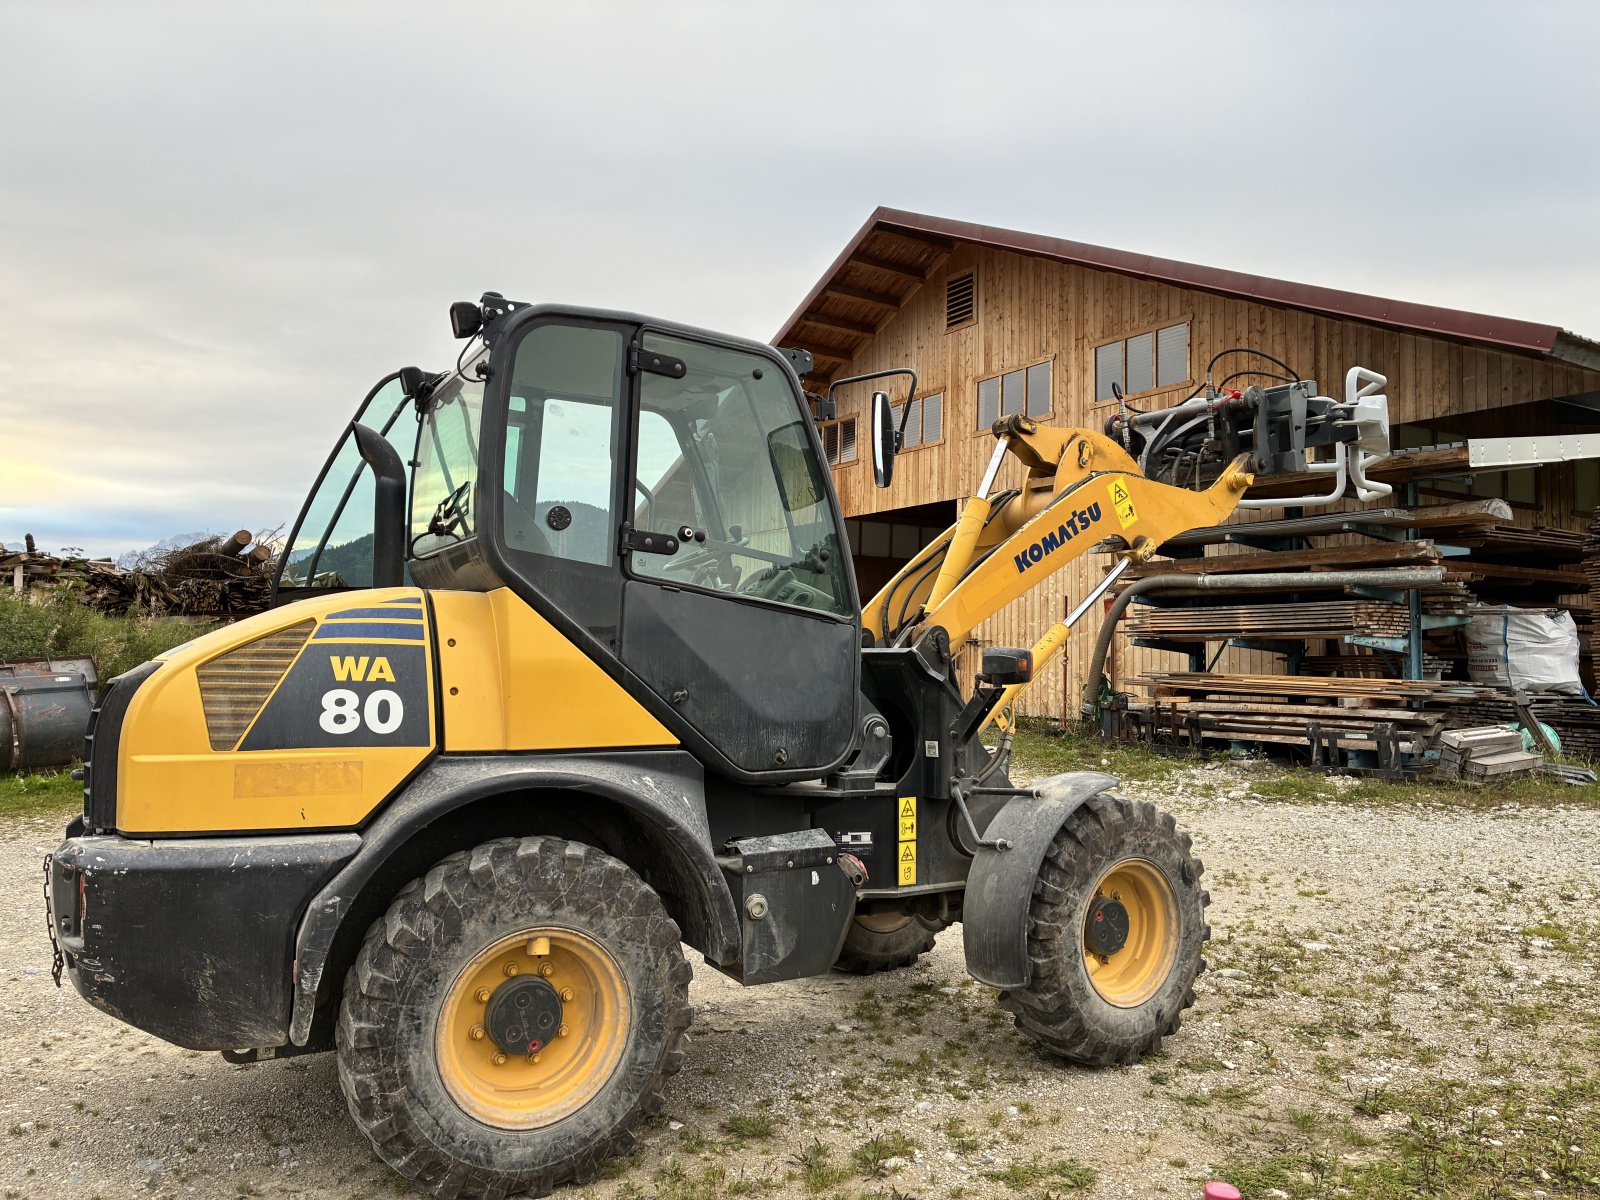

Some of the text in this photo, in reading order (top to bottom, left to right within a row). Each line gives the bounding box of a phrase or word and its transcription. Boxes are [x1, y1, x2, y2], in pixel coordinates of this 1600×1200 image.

[1014, 501, 1102, 573] KOMATSU
[330, 656, 396, 682] WA
[319, 689, 404, 734] 80
